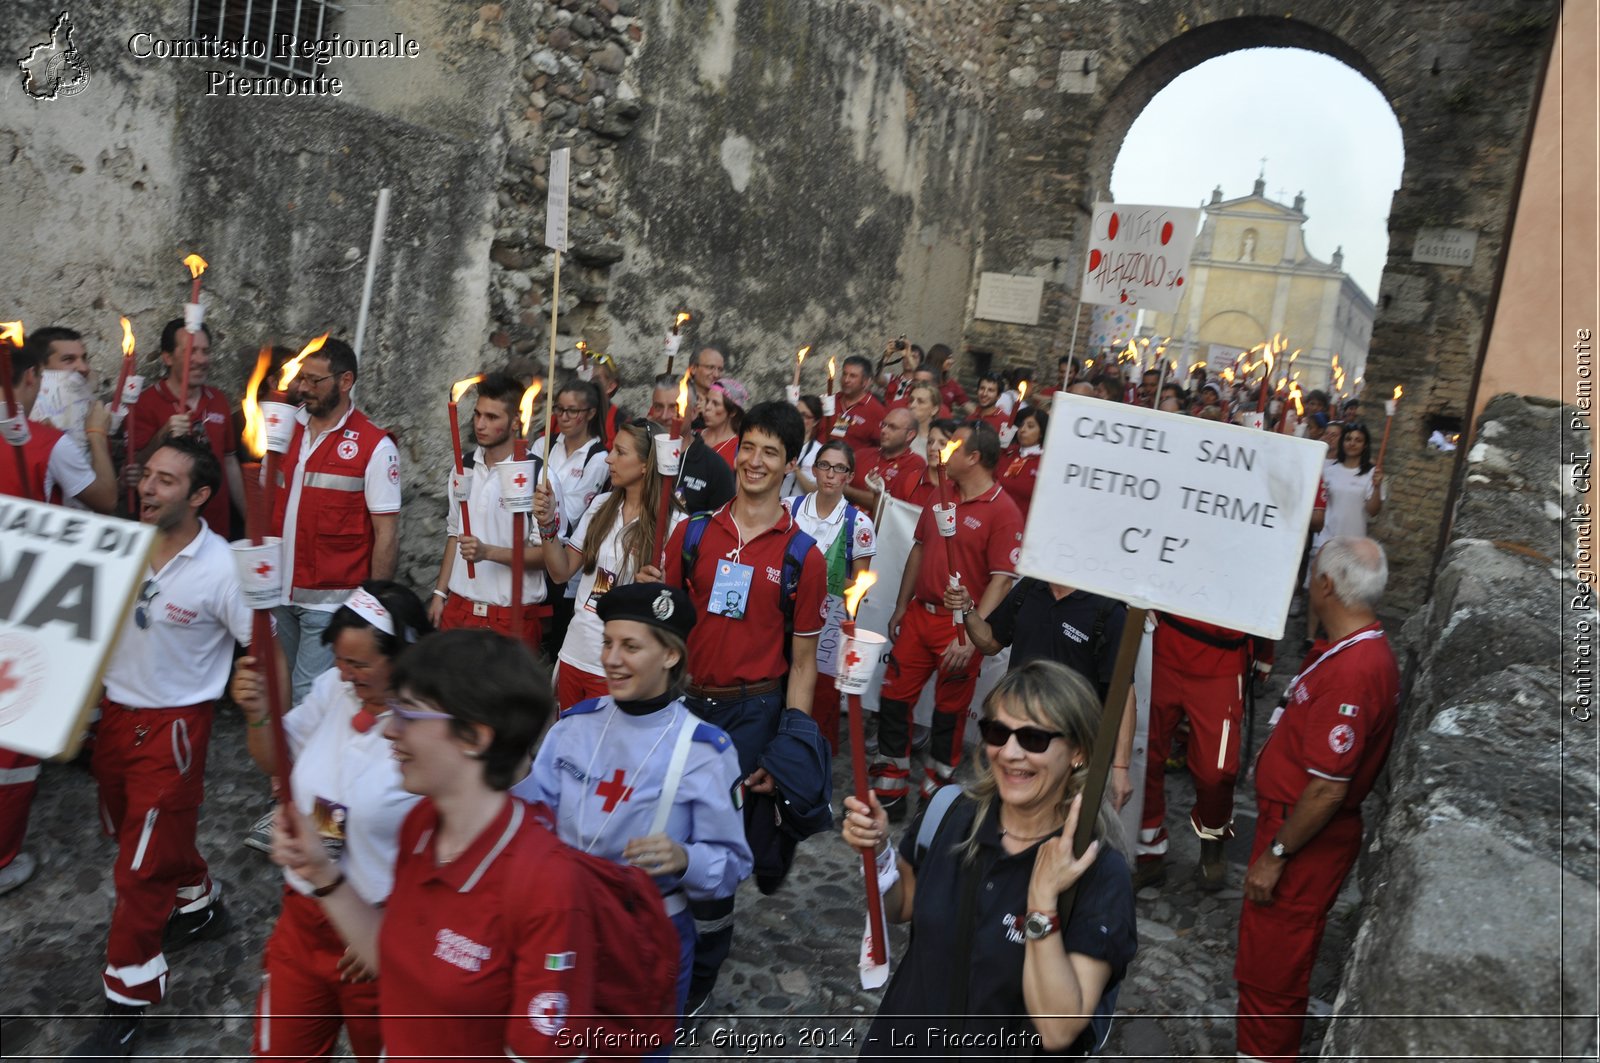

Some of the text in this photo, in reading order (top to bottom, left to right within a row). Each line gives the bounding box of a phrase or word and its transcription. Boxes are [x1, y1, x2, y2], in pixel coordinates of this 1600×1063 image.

[1095, 209, 1175, 247] COMITATO
[1418, 245, 1472, 260] CASTELLO
[1073, 416, 1257, 472] CASTEL SAN
[1063, 463, 1279, 529] PIETRO TERME
